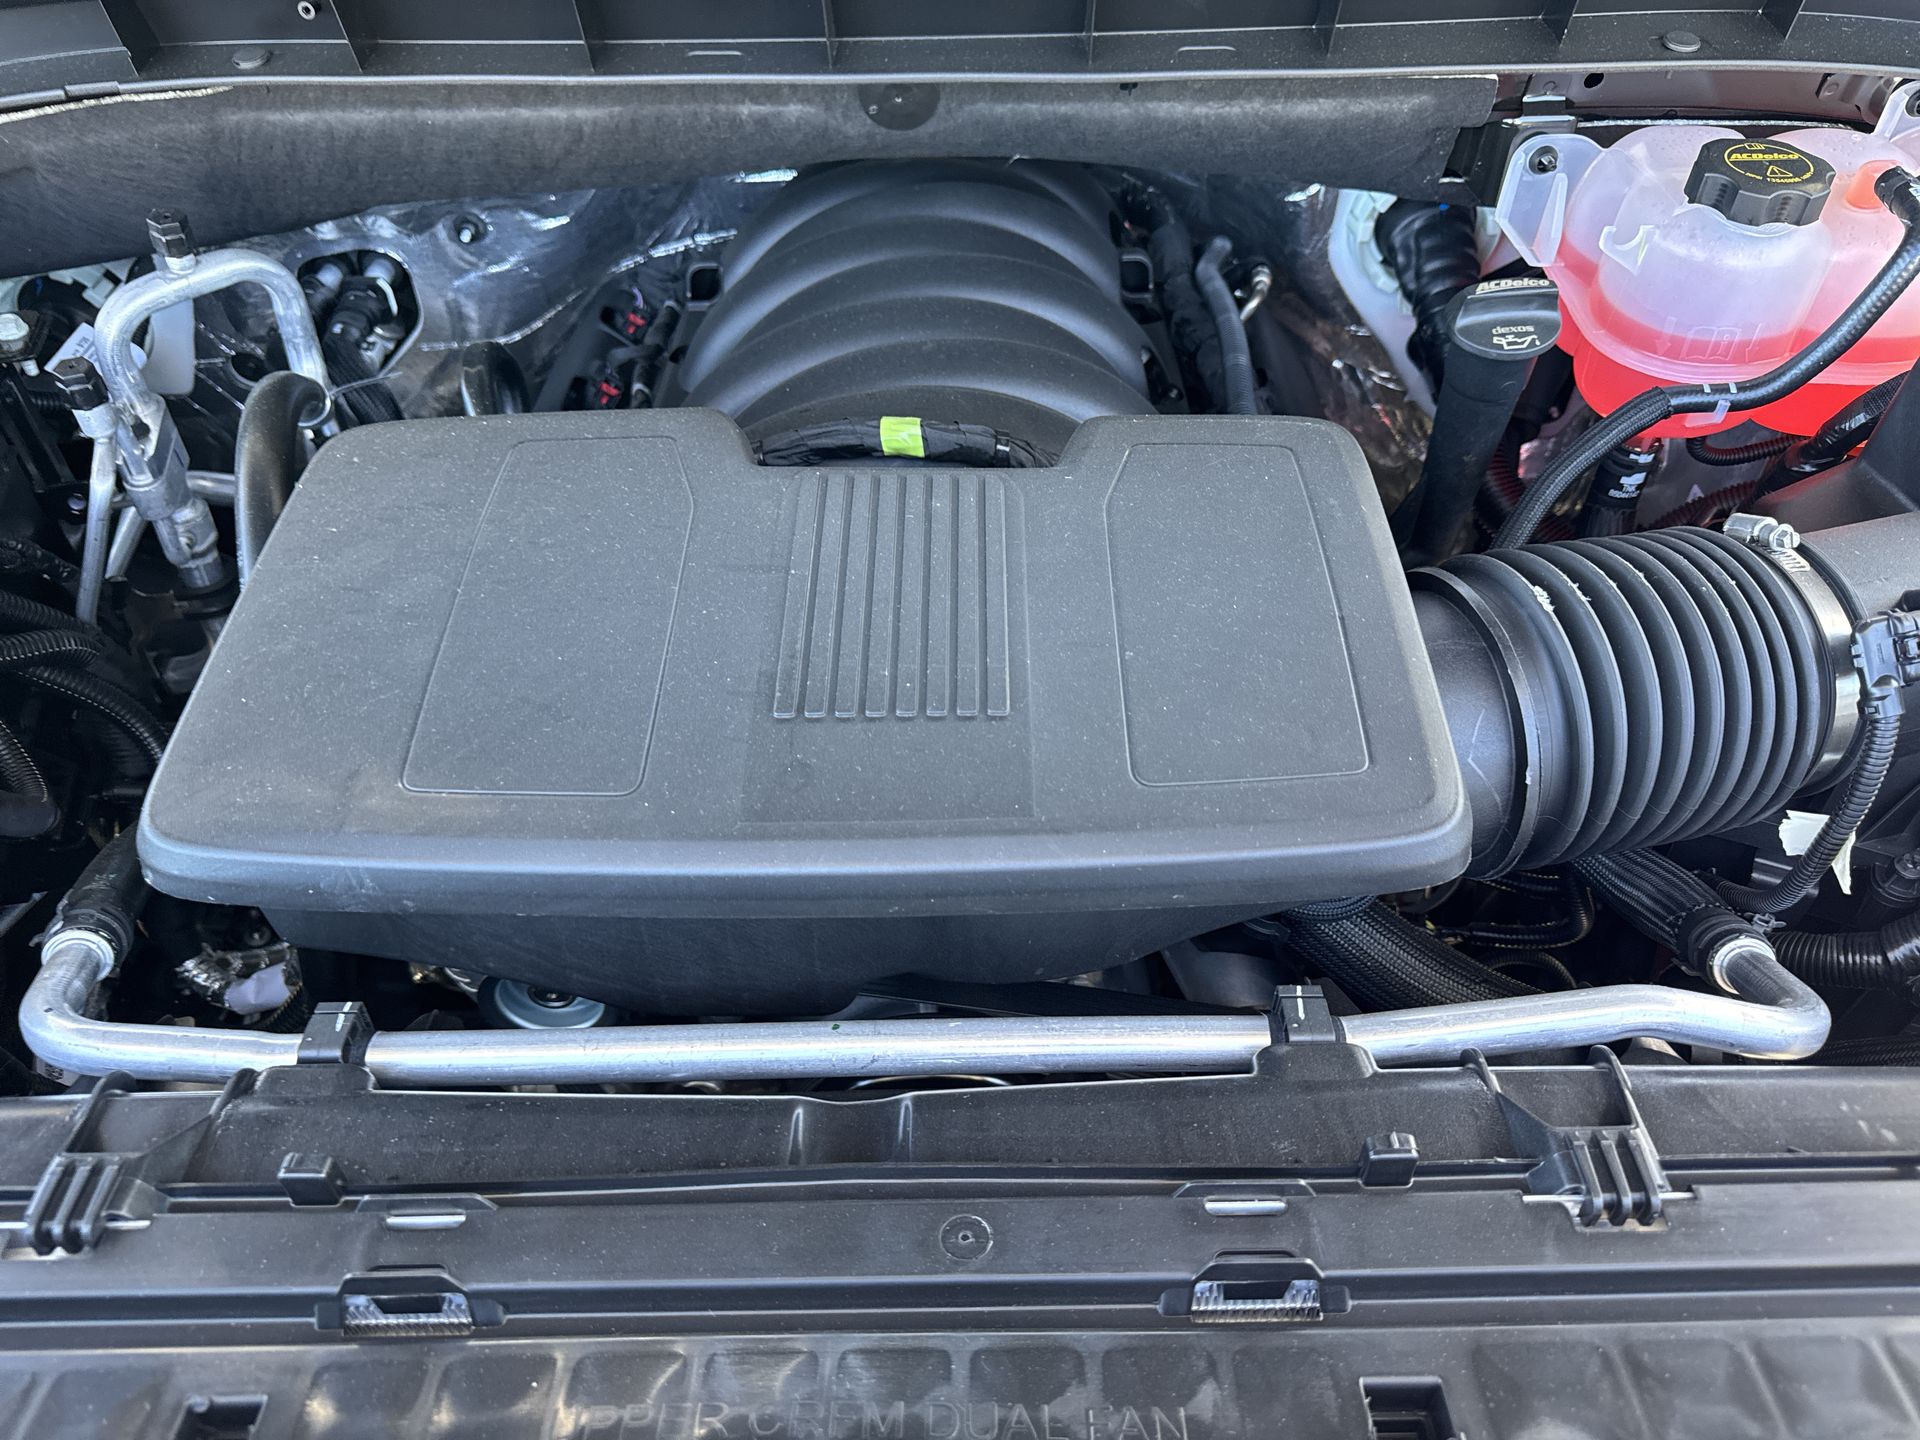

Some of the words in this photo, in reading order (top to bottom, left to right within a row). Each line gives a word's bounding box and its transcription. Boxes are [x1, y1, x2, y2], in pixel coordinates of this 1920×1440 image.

[1729, 152, 1799, 160] ACDelco
[1475, 278, 1550, 293] ACDelco
[1491, 325, 1535, 335] dexos
[924, 1400, 1070, 1440] DUAL
[1085, 1404, 1189, 1440] FAN
